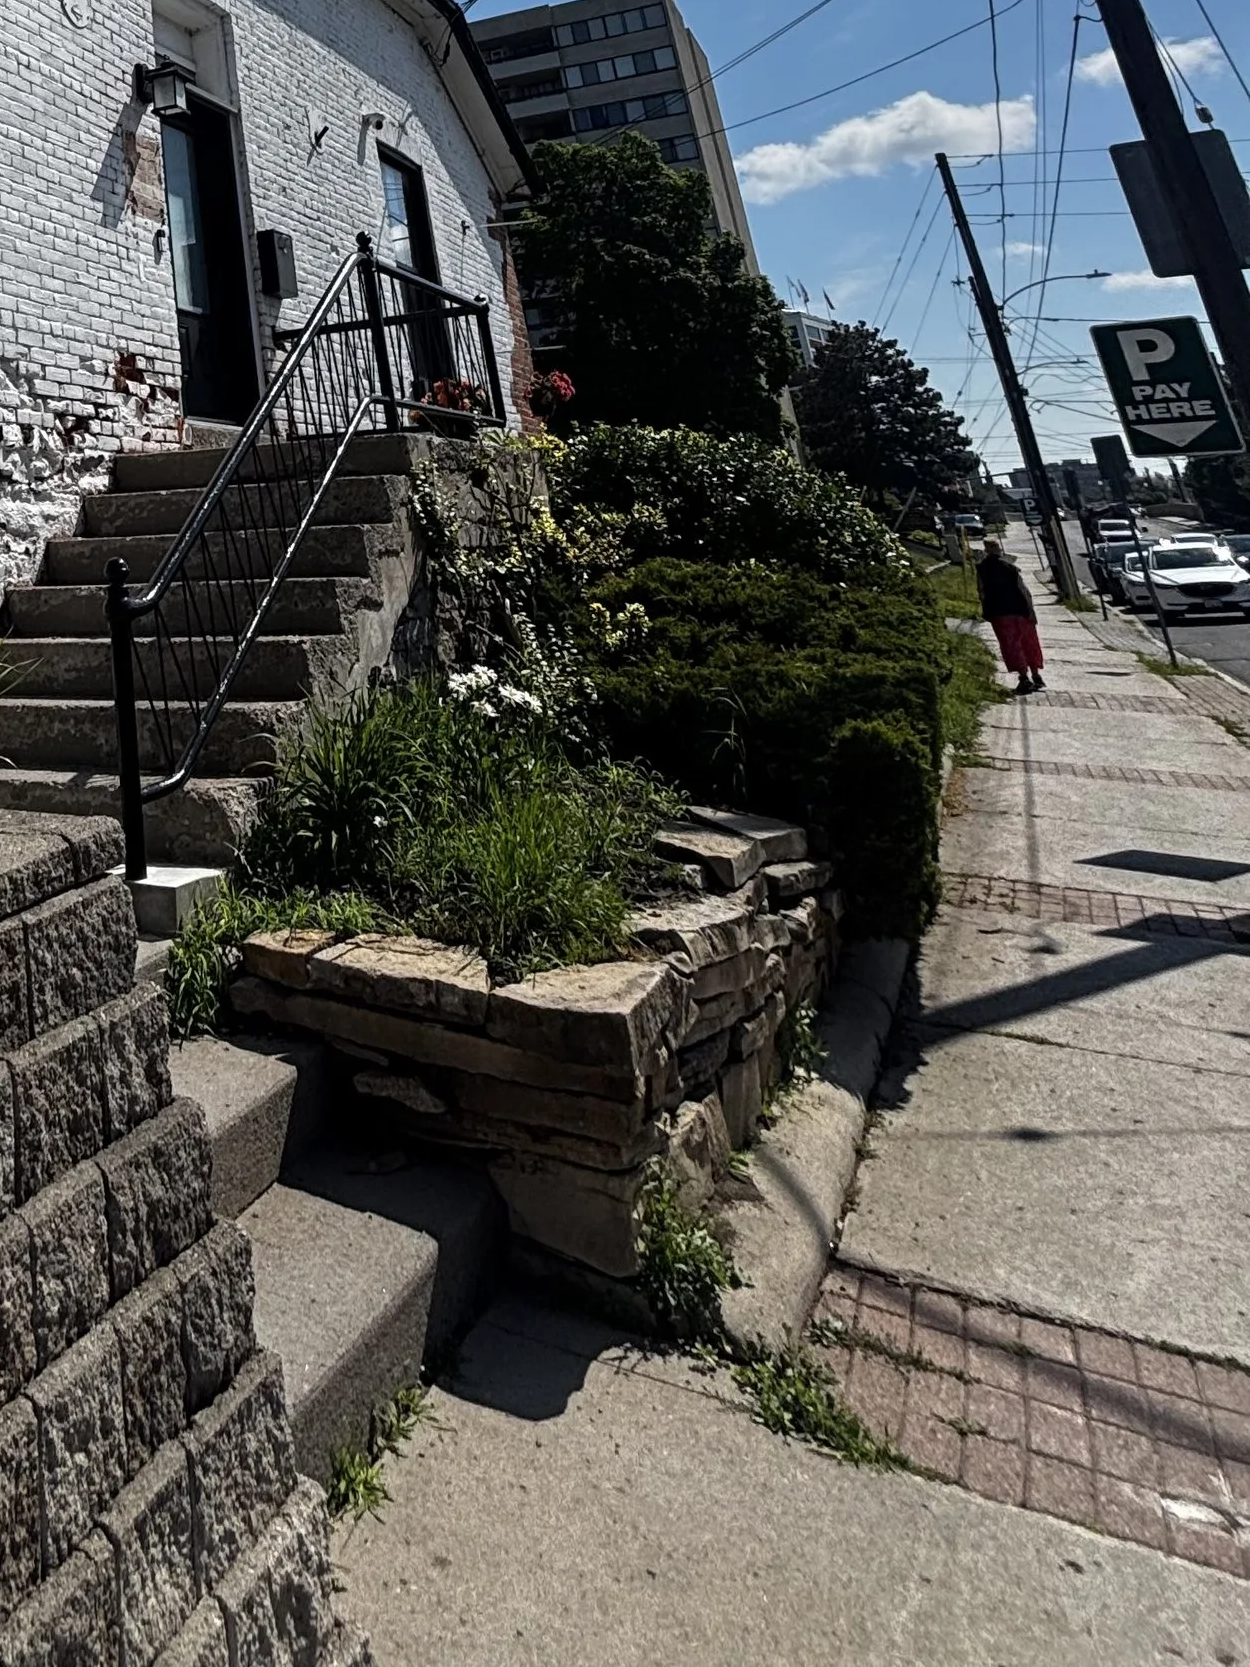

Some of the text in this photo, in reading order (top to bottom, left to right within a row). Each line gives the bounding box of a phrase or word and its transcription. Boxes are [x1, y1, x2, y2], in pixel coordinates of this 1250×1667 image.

[1116, 328, 1176, 381] P
[1131, 382, 1192, 401] PAY
[1125, 399, 1216, 420] HERE
[1023, 498, 1036, 511] P
